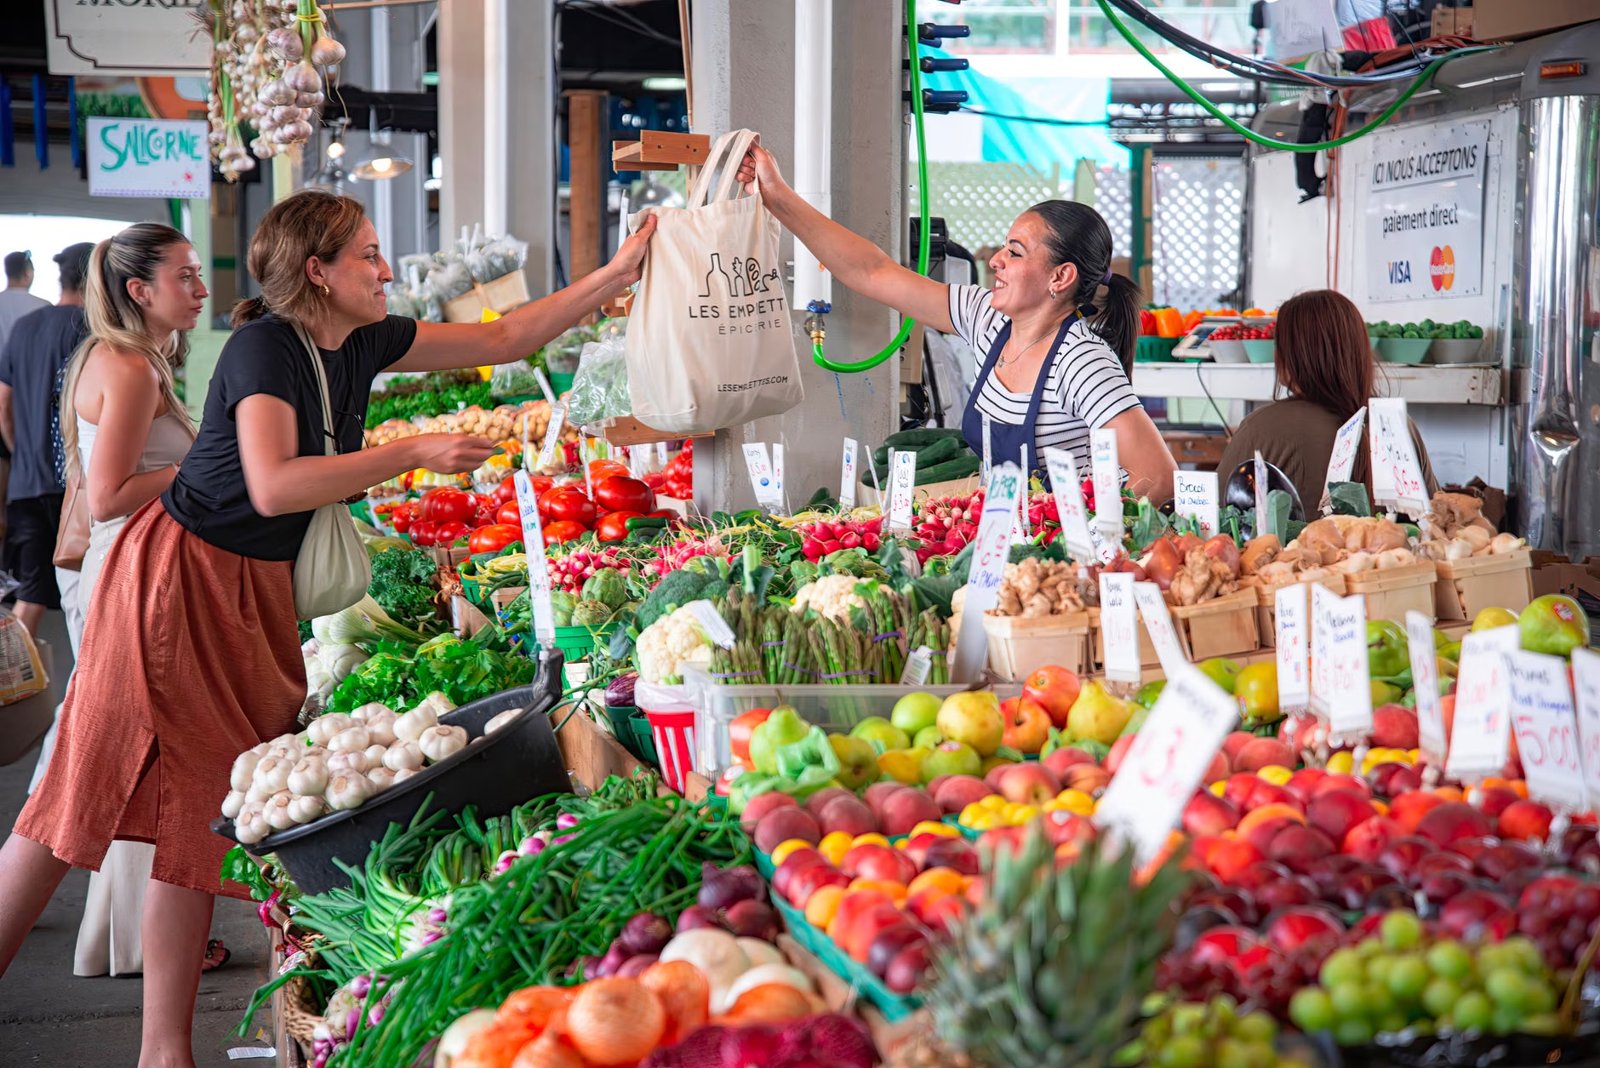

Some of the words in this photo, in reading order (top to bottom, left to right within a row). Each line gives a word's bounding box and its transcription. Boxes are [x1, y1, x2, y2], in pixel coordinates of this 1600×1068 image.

[100, 123, 203, 172] SALICORNE
[1372, 161, 1385, 185] ICI
[1386, 156, 1415, 182] NOUS
[1415, 144, 1478, 177] ACCEPTONS
[1382, 209, 1428, 239] paiement
[1429, 203, 1459, 228] direct
[1388, 260, 1412, 285] VISA
[688, 305, 720, 319] LES
[728, 297, 784, 319] EMPETT
[718, 318, 782, 336] ÉPICRIE
